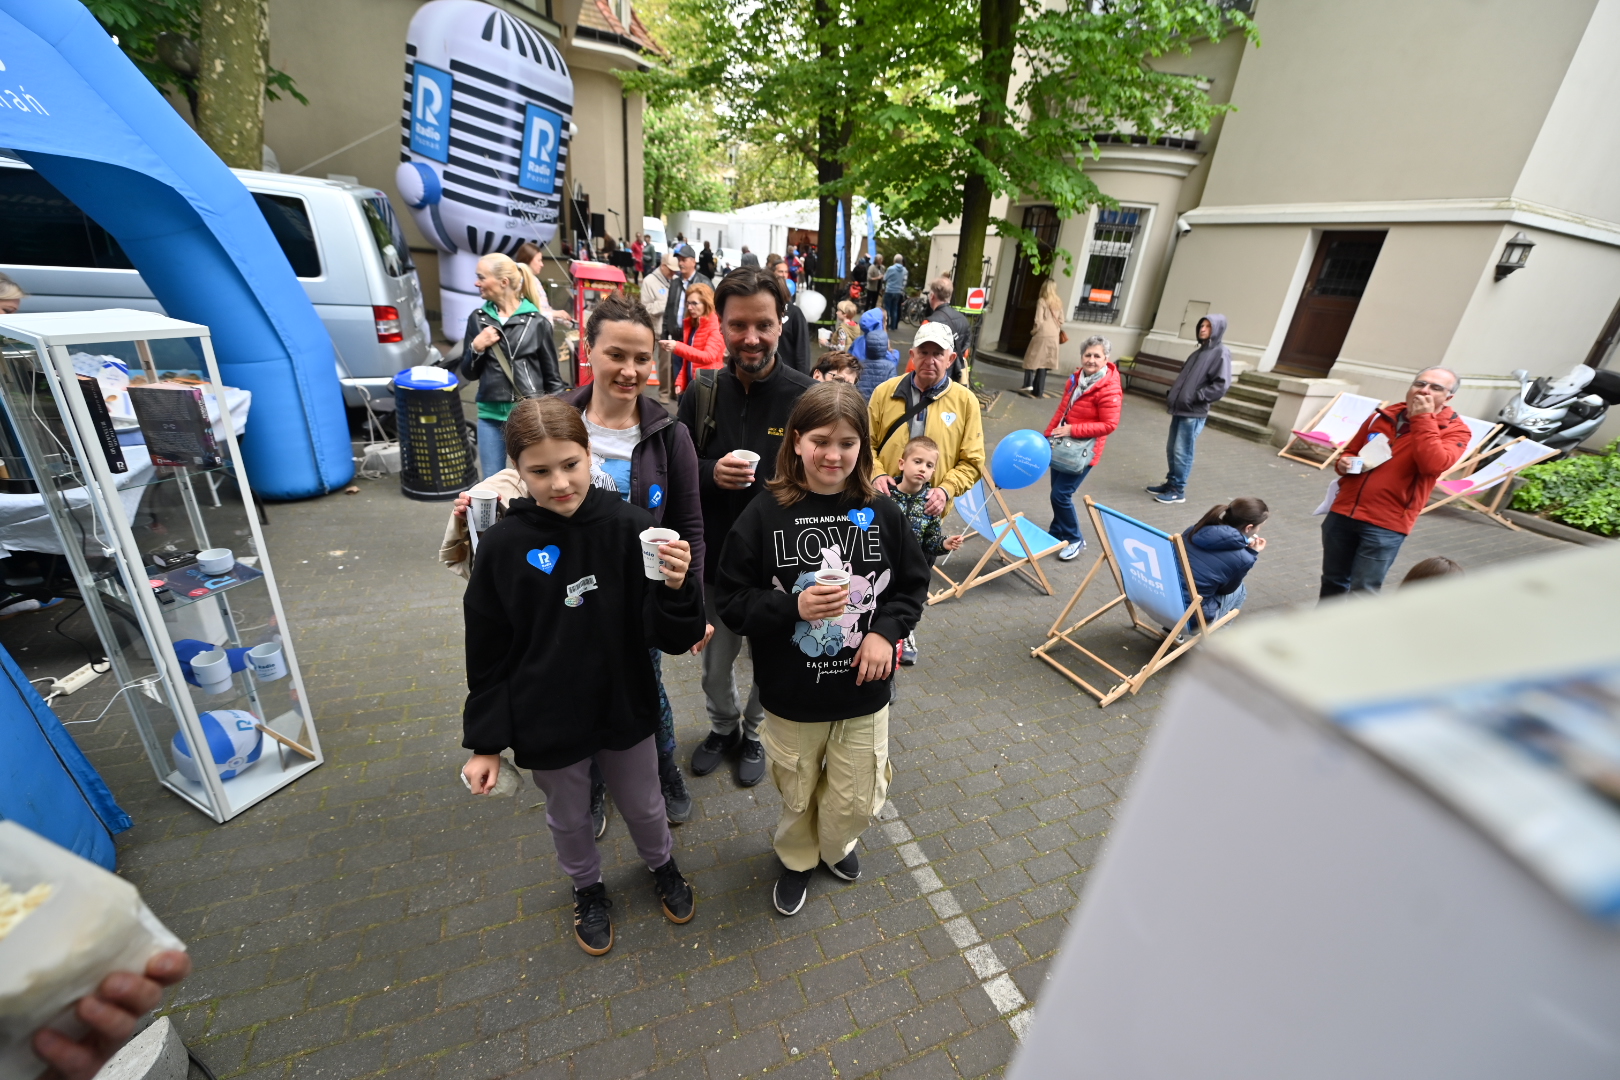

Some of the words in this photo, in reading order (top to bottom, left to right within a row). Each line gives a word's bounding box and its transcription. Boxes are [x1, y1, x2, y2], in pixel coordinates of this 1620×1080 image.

[0, 85, 50, 116] ań
[415, 122, 441, 141] Radio
[527, 161, 551, 176] Radio
[794, 516, 819, 525] STITCH
[820, 515, 835, 523] AND
[773, 525, 882, 567] LOVE
[806, 661, 829, 669] EACH
[832, 657, 852, 667] OTHE
[815, 667, 850, 684] forever
